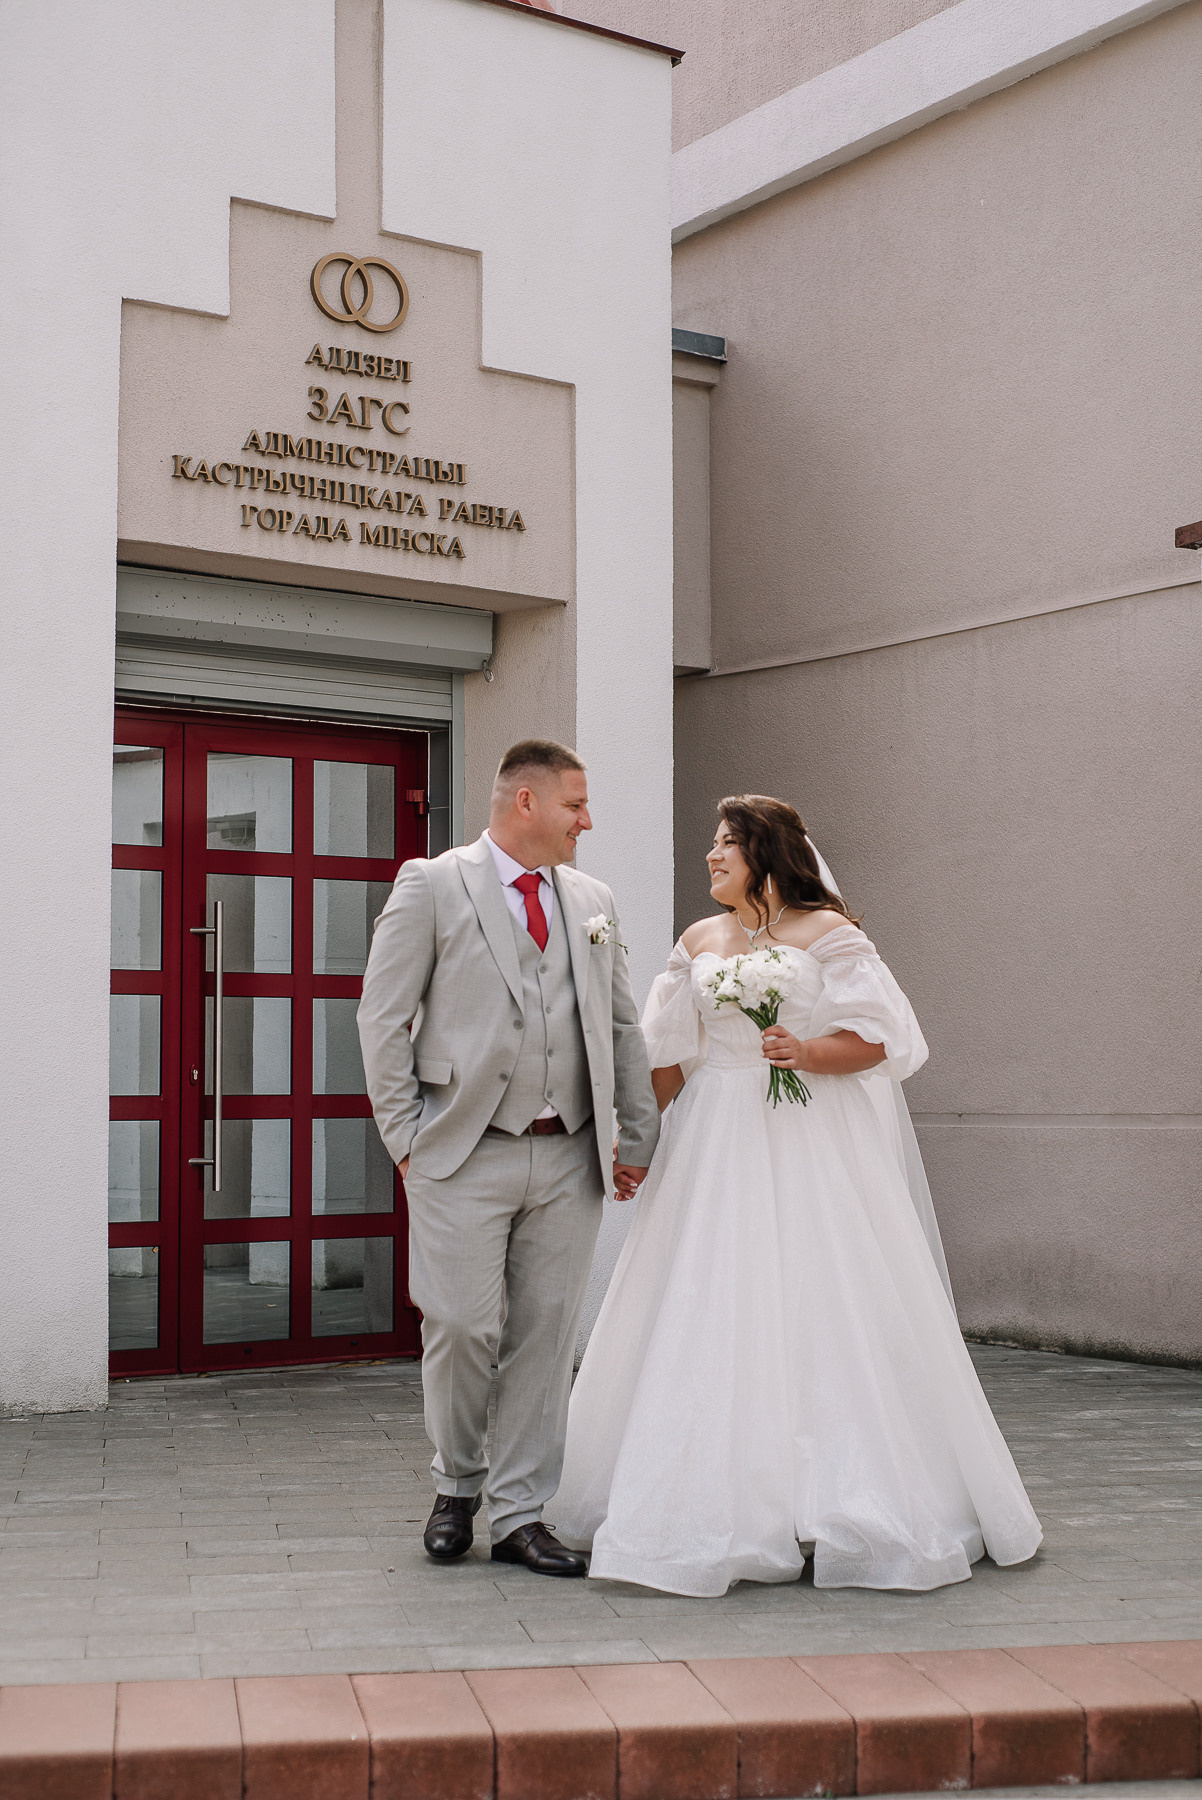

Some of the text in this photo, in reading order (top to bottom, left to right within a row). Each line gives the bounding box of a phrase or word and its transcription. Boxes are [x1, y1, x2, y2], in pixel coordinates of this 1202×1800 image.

[305, 343, 413, 382] АДДЗЕЛ
[307, 386, 412, 435] ЗАГС
[241, 429, 467, 485] АДМІНІСТРАЦЫІ
[172, 454, 429, 517] КАСТРЫЧНІЦКАГА
[240, 504, 466, 558] ГОРАДА МІНСКА
